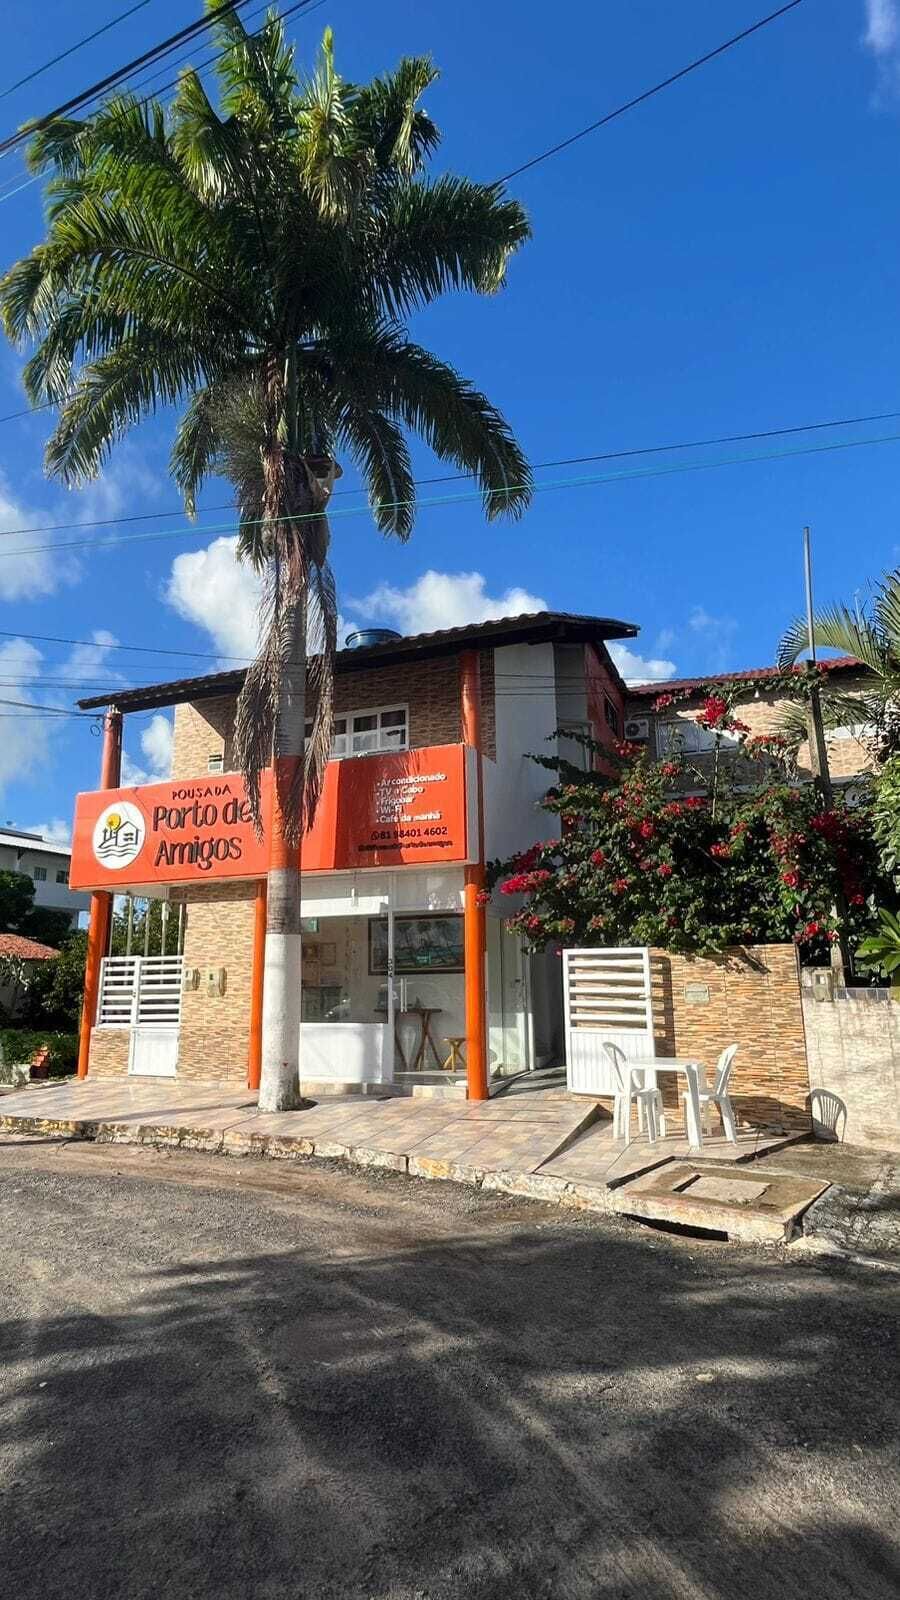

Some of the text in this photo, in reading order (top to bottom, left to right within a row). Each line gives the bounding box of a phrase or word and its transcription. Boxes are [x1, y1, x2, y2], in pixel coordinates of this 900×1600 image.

[391, 772, 447, 785] condicionado
[172, 784, 232, 800] POUSADA
[401, 785, 425, 794] Cabo
[153, 797, 254, 832] Porto de
[400, 814, 413, 822] da
[415, 811, 442, 821] manhã
[423, 826, 448, 837] 4602
[154, 835, 242, 870] Amigos
